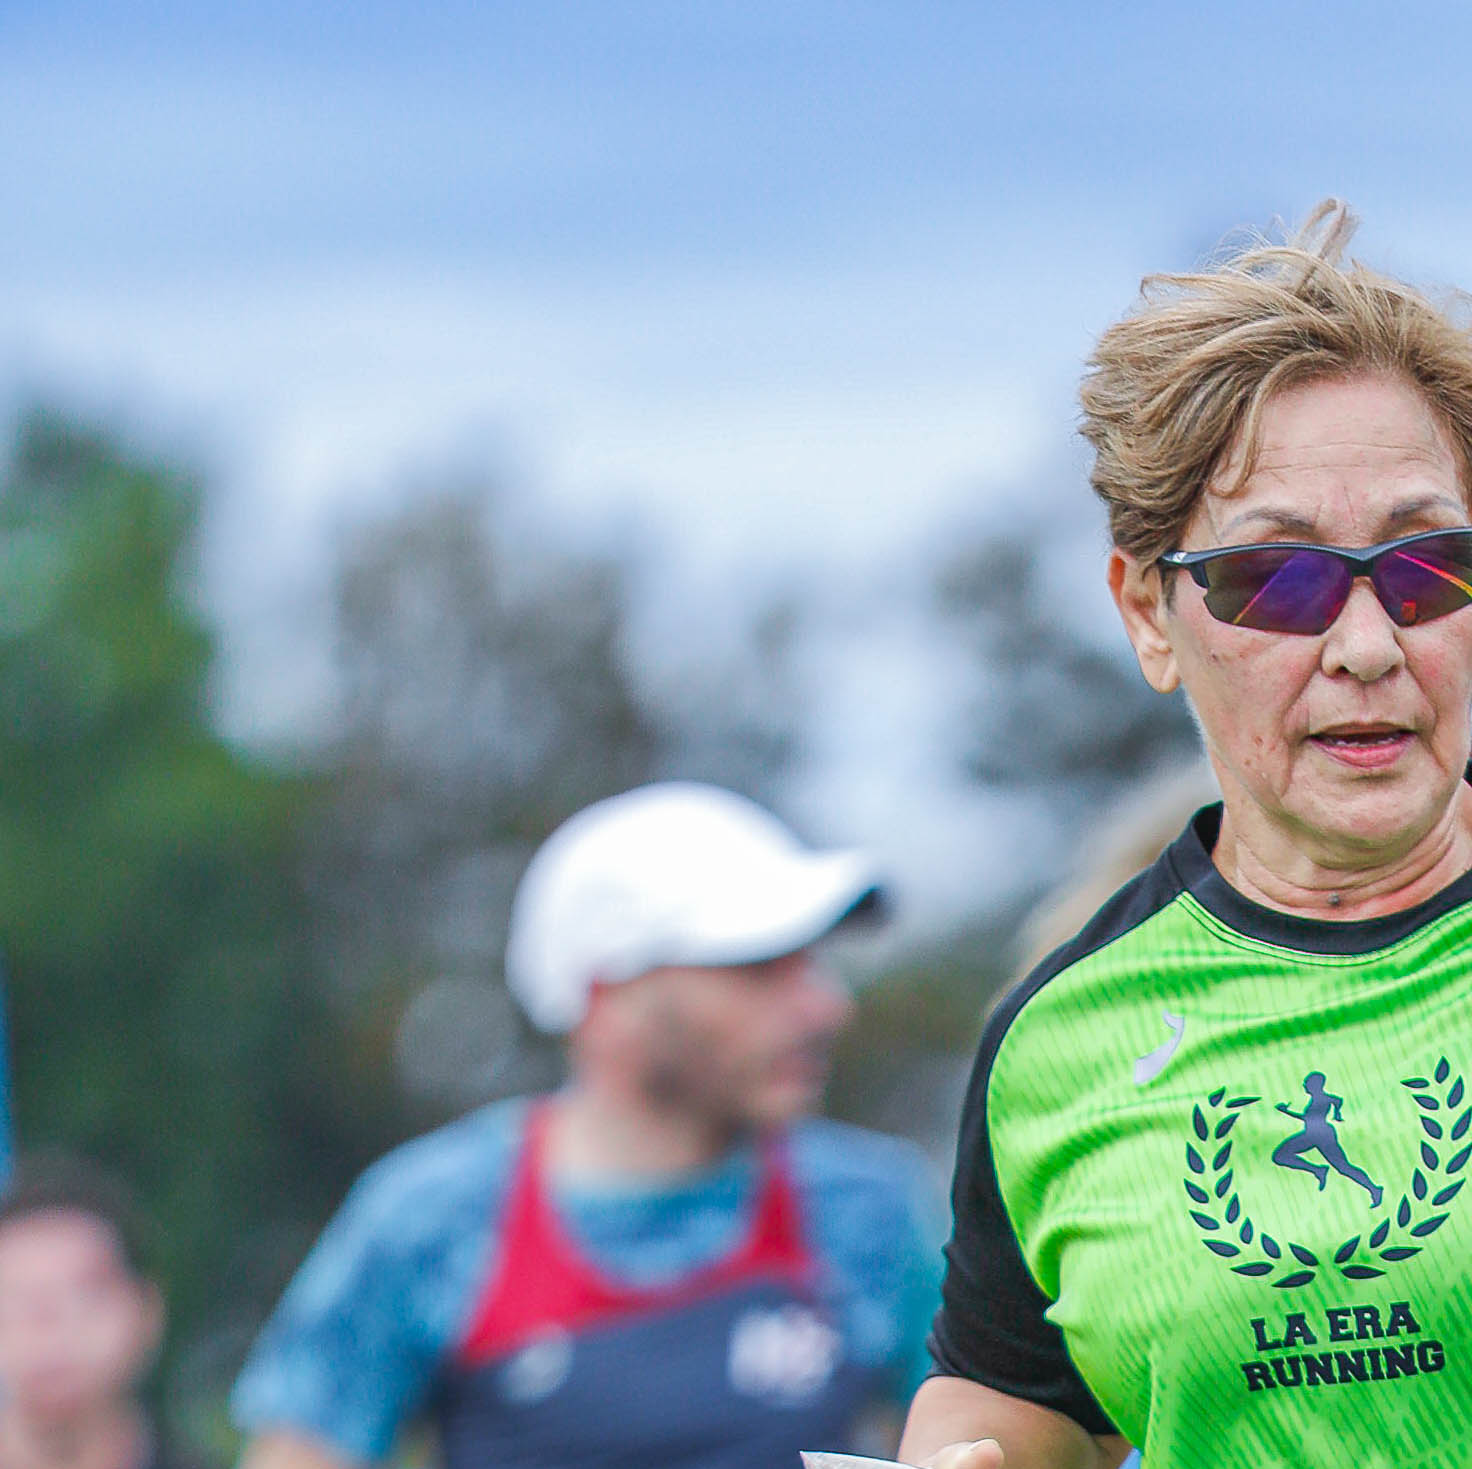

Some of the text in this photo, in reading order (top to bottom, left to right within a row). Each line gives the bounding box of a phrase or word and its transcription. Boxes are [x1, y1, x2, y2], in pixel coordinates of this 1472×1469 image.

[1250, 1302, 1422, 1352] LA ERA
[1240, 1339, 1447, 1391] RUNNING
